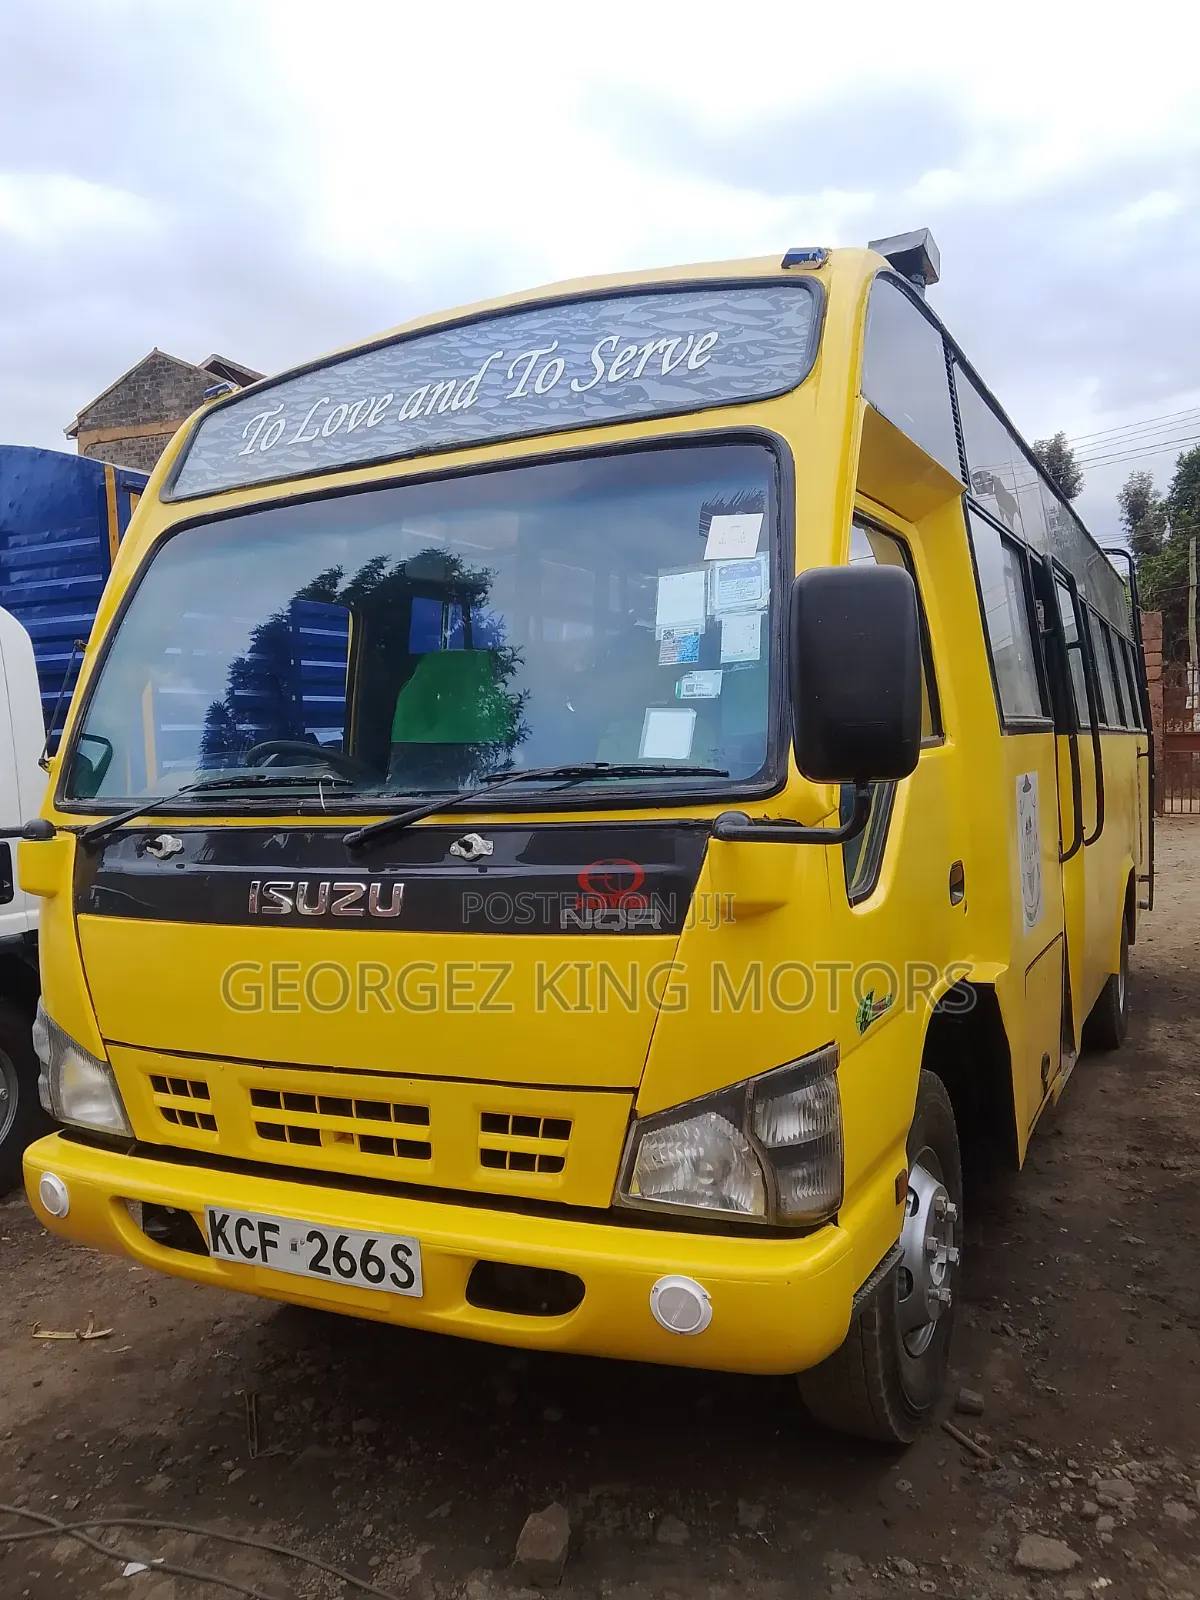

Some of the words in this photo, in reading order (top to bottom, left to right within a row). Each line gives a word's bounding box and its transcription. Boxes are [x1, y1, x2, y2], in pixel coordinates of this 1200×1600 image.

[239, 404, 284, 457] To
[287, 391, 394, 445] Love
[398, 350, 504, 421] and
[507, 341, 567, 398] To
[571, 331, 720, 393] Serve
[248, 880, 405, 918] ISUZU
[560, 908, 662, 931] NQR
[209, 1210, 279, 1263] KCF
[306, 1230, 415, 1289] 266S
